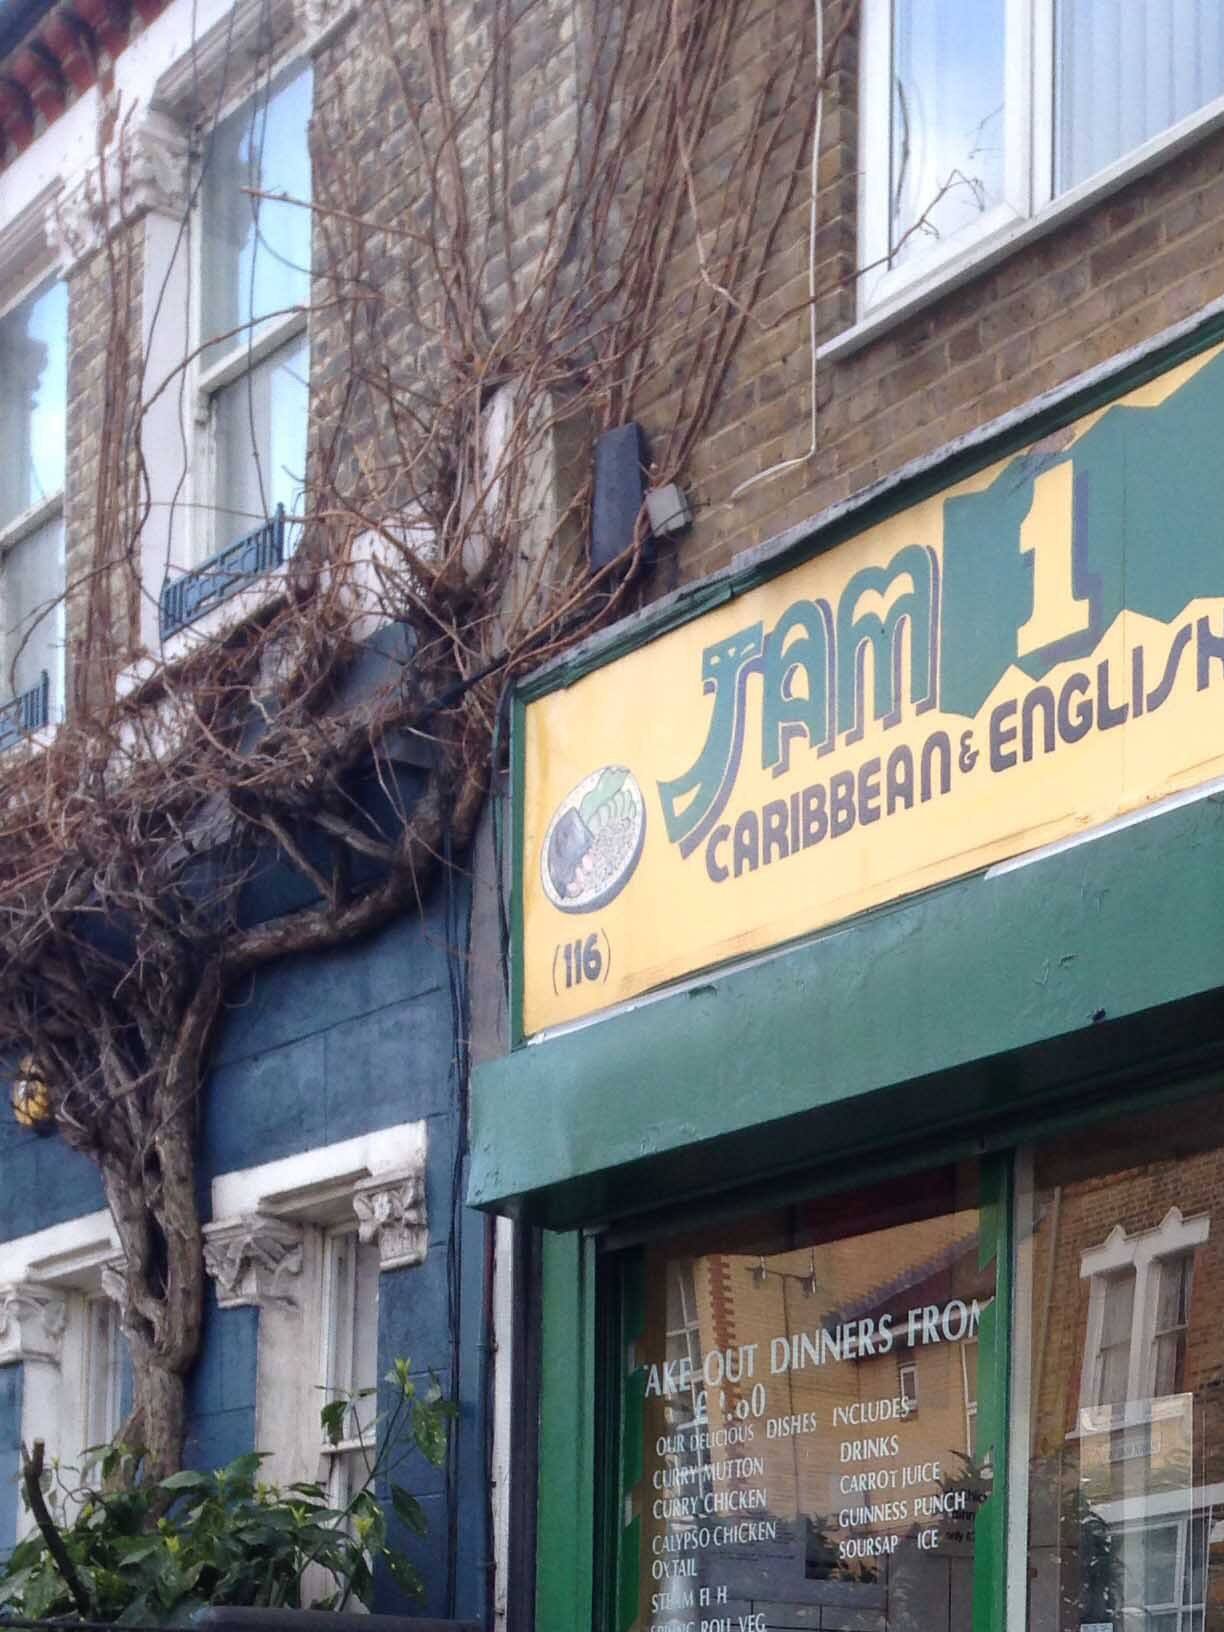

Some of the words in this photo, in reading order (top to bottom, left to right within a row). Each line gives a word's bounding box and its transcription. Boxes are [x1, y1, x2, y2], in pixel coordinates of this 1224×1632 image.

[656, 543, 940, 860] JAM
[1017, 456, 1102, 670] 1
[704, 730, 951, 884] CARIBBEAN
[958, 730, 980, 773] &
[643, 1356, 692, 1398] AKE
[704, 1343, 758, 1387] OUT
[770, 1313, 894, 1375] DINNERS
[656, 1433, 685, 1456] OUR
[690, 1423, 754, 1452] DELICIOUS
[766, 1411, 817, 1439] DISHES
[832, 1396, 910, 1427] INCLUDES
[840, 1434, 899, 1463] DRINKS
[653, 1465, 699, 1490] CURRY
[703, 1457, 765, 1482] MUTTON
[840, 1469, 898, 1495] CARROT
[902, 1461, 941, 1488] JUICE
[653, 1495, 699, 1520] CURRY
[704, 1488, 768, 1513] CHICKEN
[839, 1500, 908, 1528] GUINNESS
[914, 1491, 966, 1517] PUNCH
[652, 1527, 710, 1555] CALYPSO
[713, 1521, 777, 1546] CHICKEN
[839, 1535, 899, 1560] SOURSAP
[917, 1529, 939, 1550] ICE
